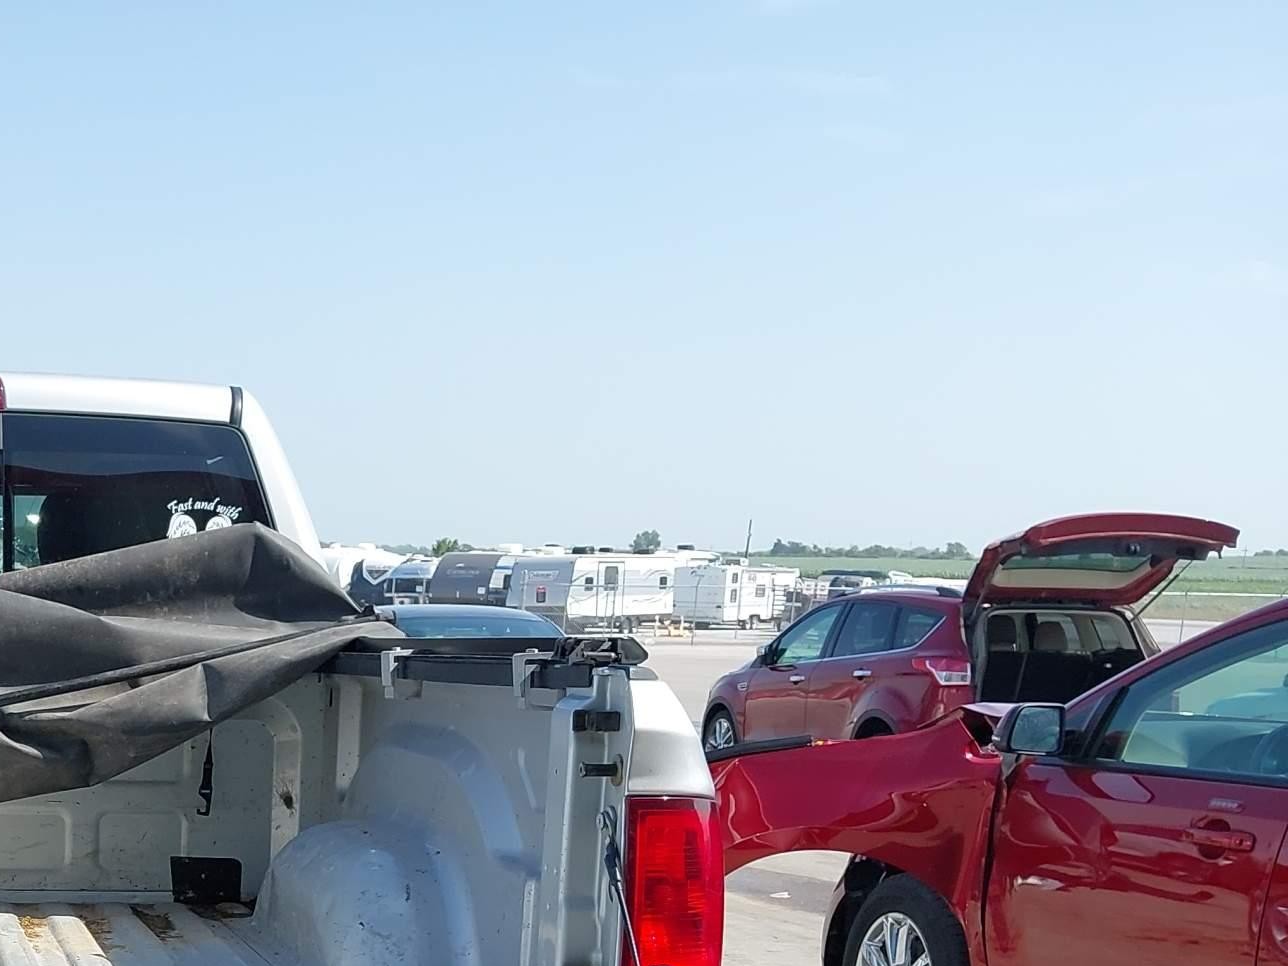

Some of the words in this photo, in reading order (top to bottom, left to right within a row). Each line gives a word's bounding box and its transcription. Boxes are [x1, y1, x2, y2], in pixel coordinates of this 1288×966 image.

[167, 498, 193, 514] Fast
[194, 497, 220, 511] and
[216, 505, 242, 520] with
